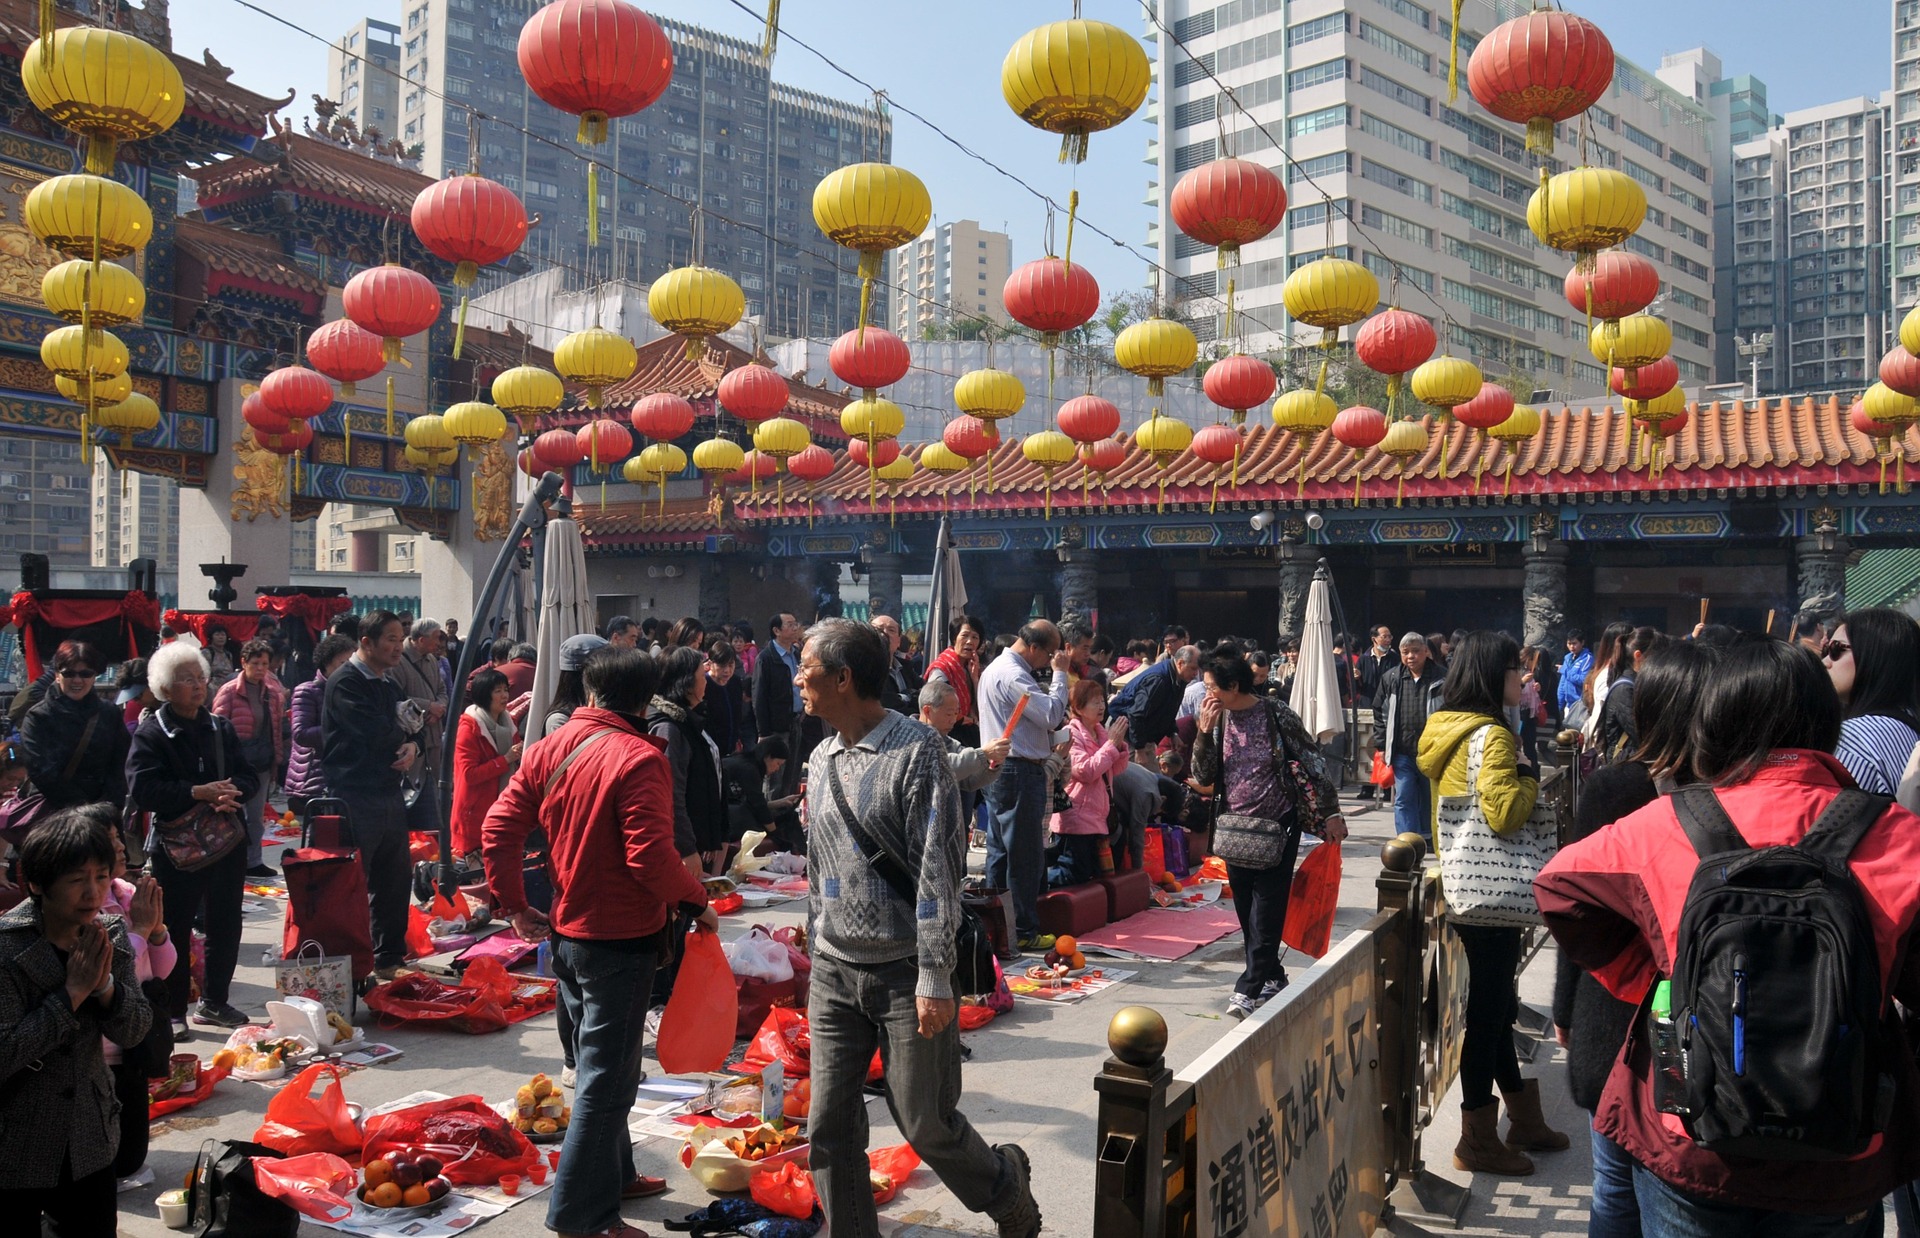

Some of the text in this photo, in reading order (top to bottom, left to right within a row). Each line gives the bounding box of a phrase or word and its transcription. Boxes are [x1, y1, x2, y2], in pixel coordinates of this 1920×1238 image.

[1208, 1011, 1367, 1238] 通道及出入口
[1303, 1158, 1348, 1238] 停留
